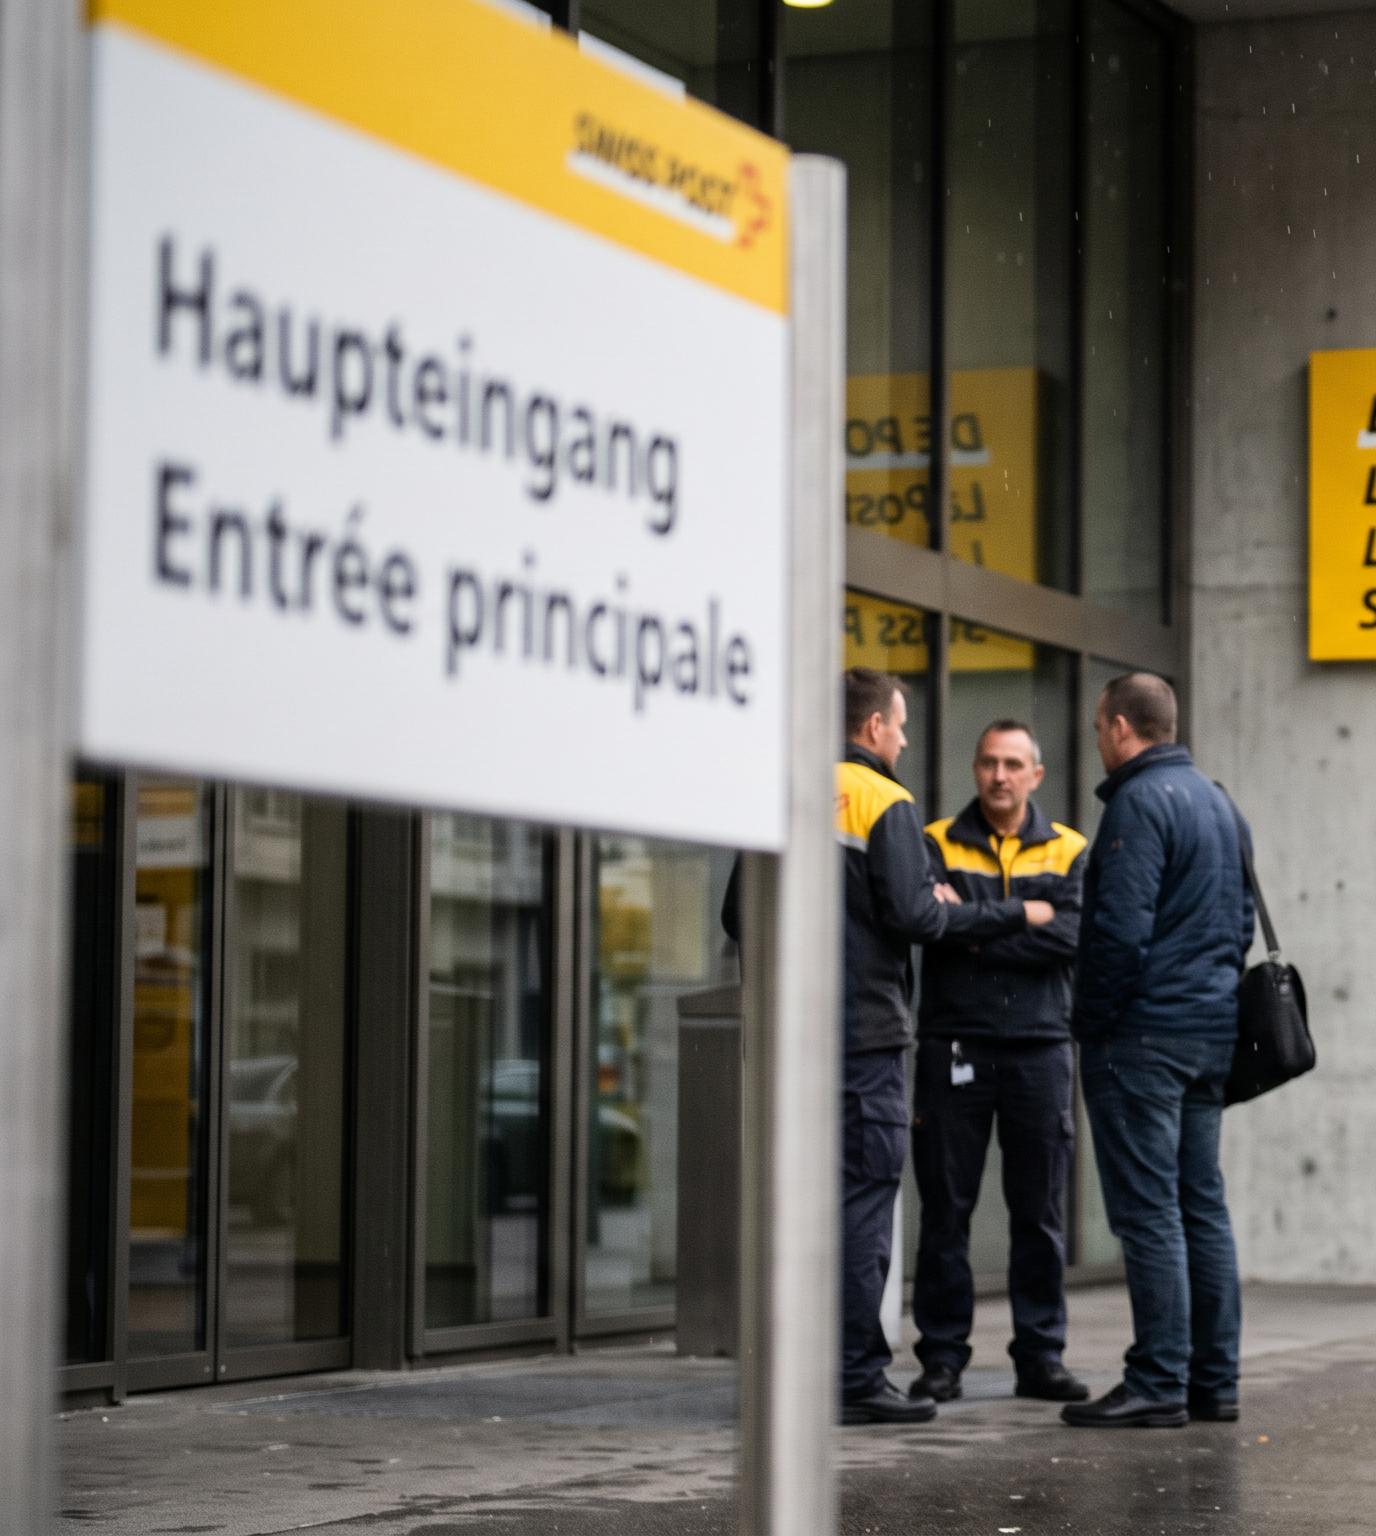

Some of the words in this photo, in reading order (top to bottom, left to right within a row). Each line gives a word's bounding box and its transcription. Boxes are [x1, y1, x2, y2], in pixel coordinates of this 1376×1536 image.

[155, 234, 681, 534] Haupteingang
[151, 457, 419, 637] Entrée
[446, 550, 754, 714] principale
